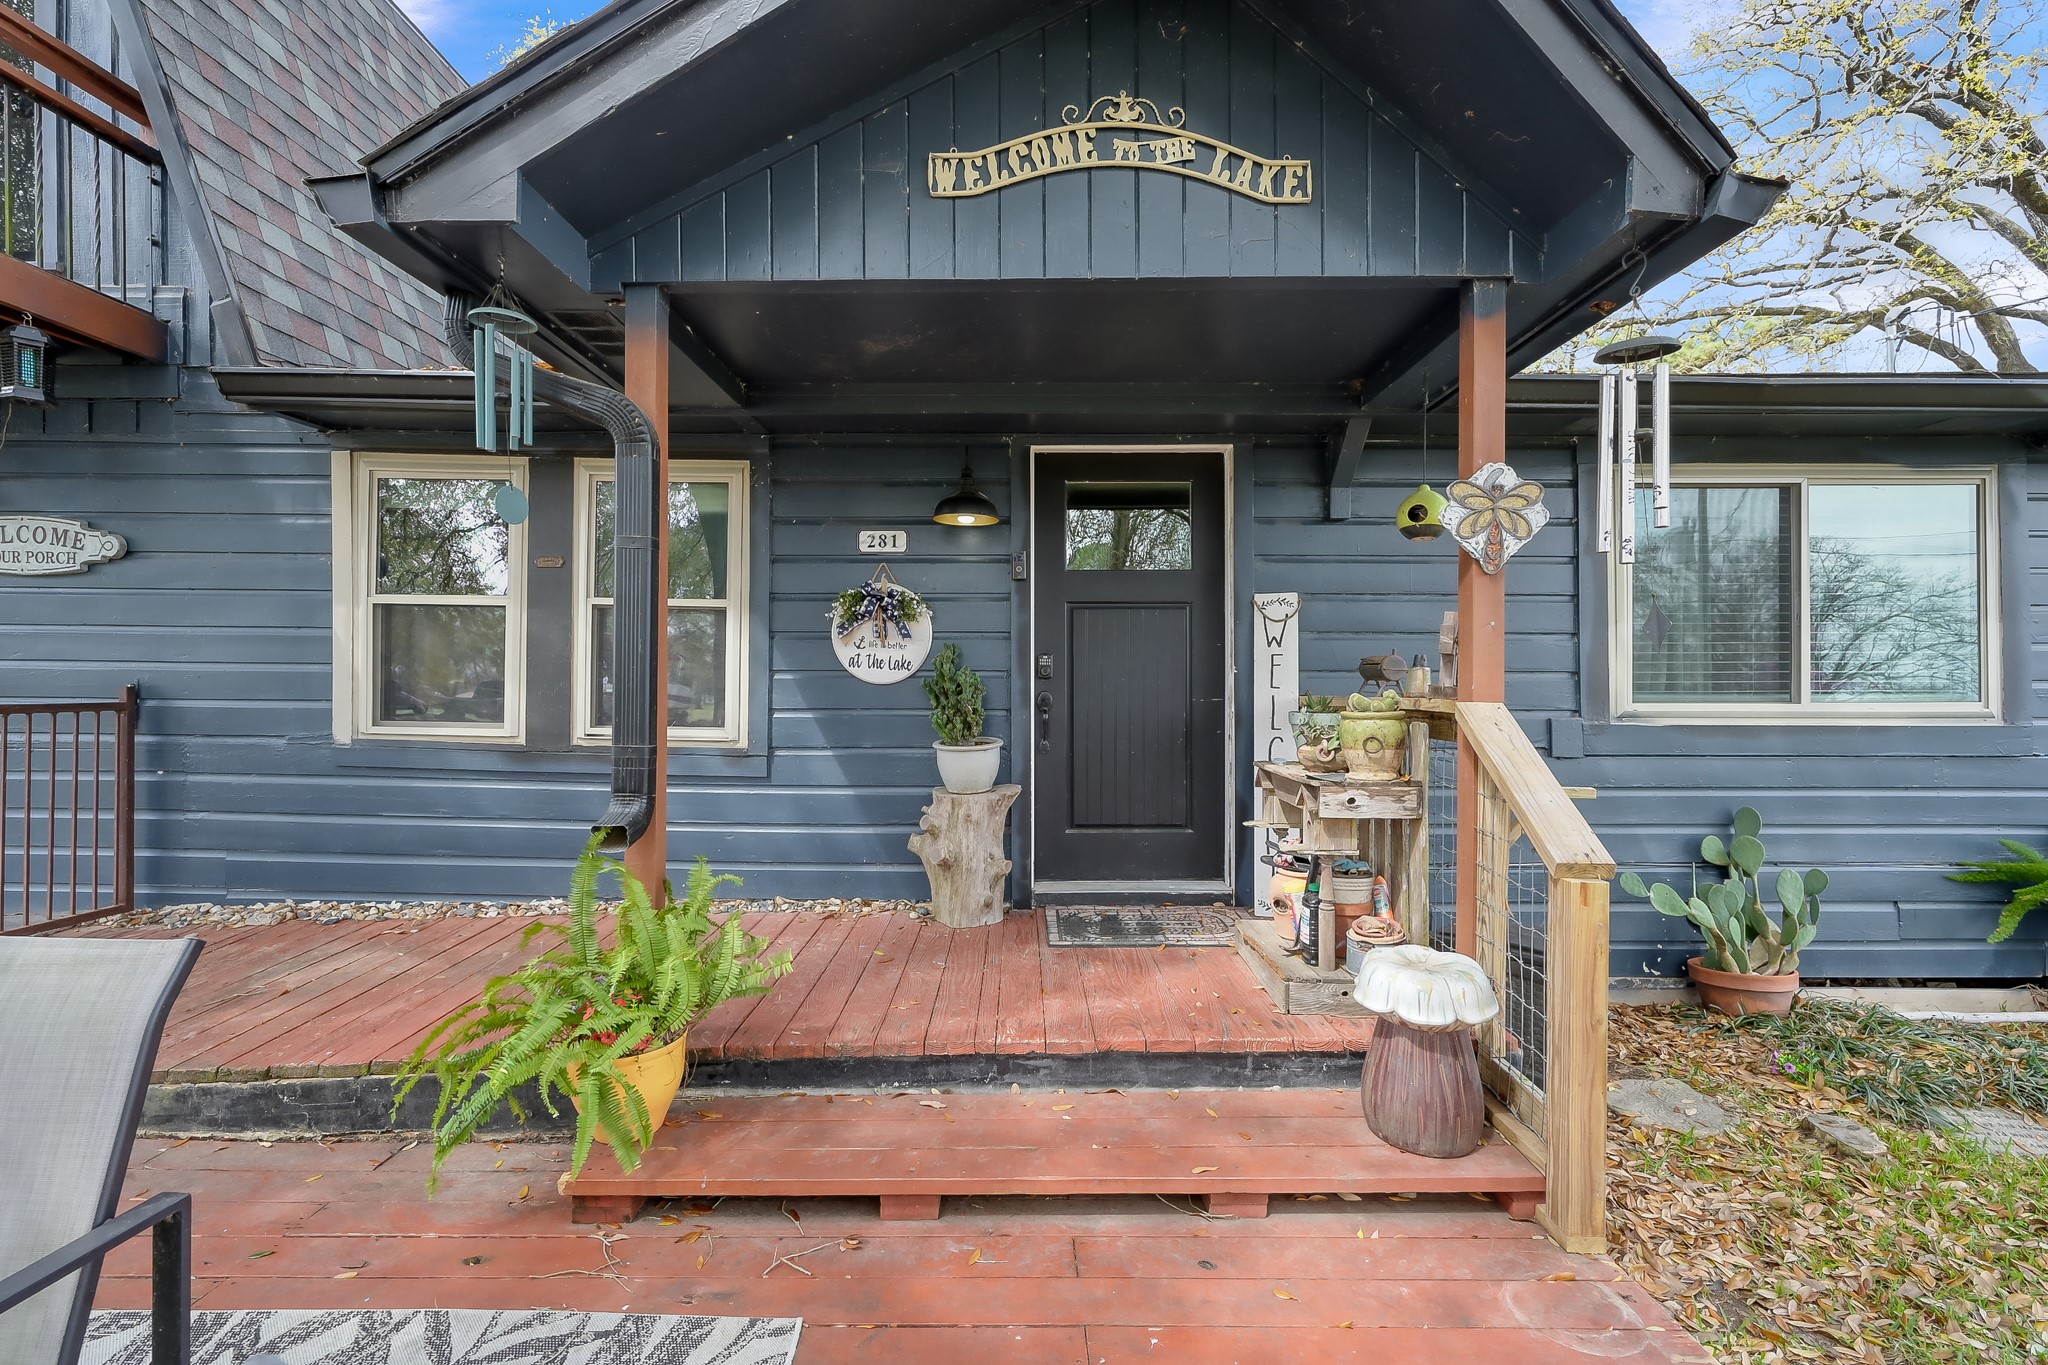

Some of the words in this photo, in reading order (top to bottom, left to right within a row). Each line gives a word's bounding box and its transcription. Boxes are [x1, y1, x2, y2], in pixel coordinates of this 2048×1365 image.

[935, 128, 1098, 193] WELCOME
[1113, 138, 1140, 161] TO
[1150, 136, 1195, 163] THE
[1209, 147, 1303, 198] LAKE
[867, 533, 898, 548] 281
[0, 550, 21, 563] UR
[26, 551, 77, 564] PORCH
[848, 653, 863, 669] at
[865, 653, 886, 669] the
